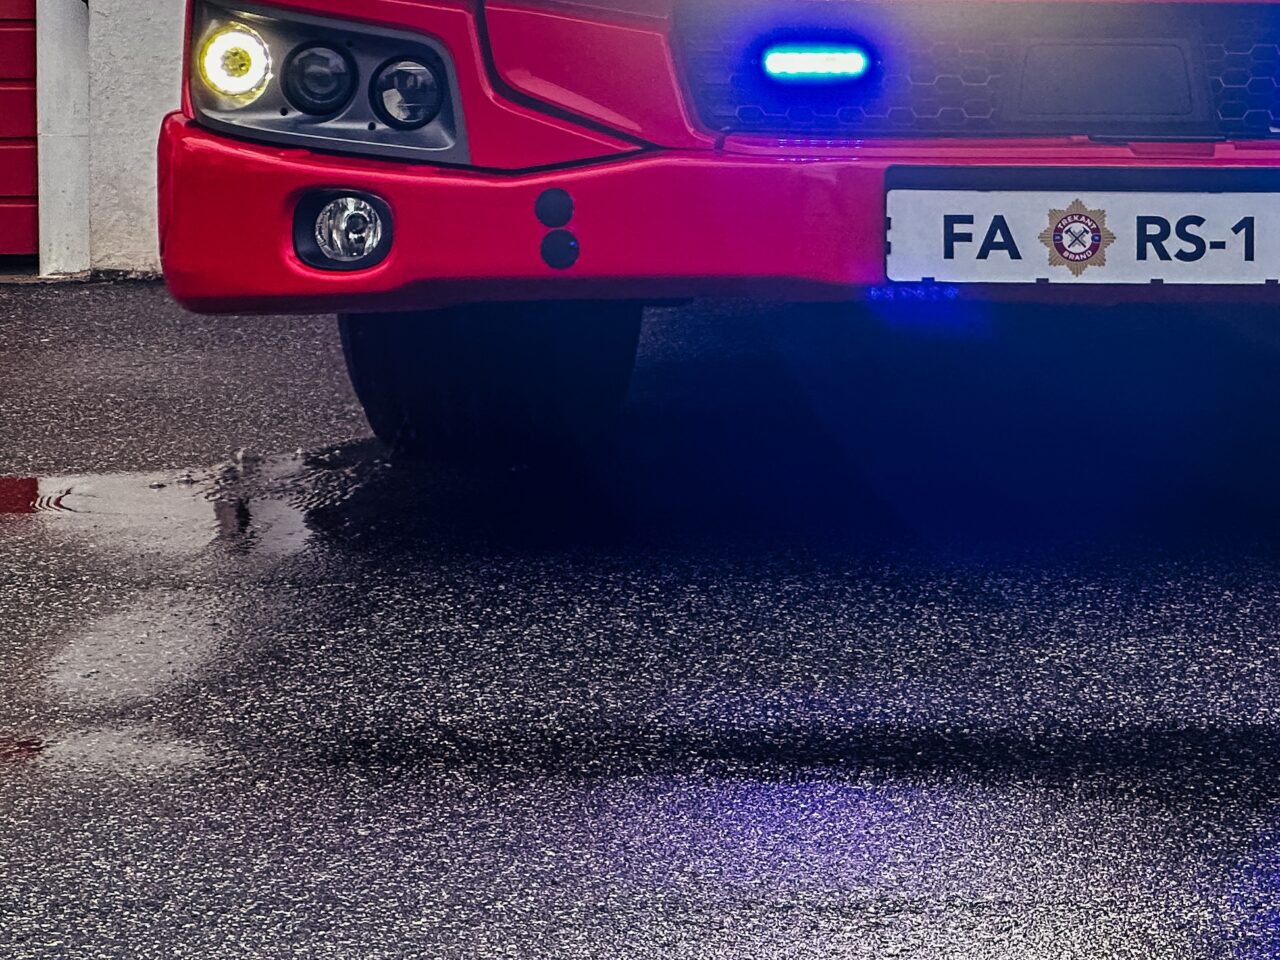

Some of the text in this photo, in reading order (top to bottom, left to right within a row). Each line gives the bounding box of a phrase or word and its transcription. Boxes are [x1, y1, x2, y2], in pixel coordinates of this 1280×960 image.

[1057, 214, 1097, 230] TREKANT
[943, 214, 1255, 262] FA RS-1
[1062, 250, 1093, 260] BRAND
